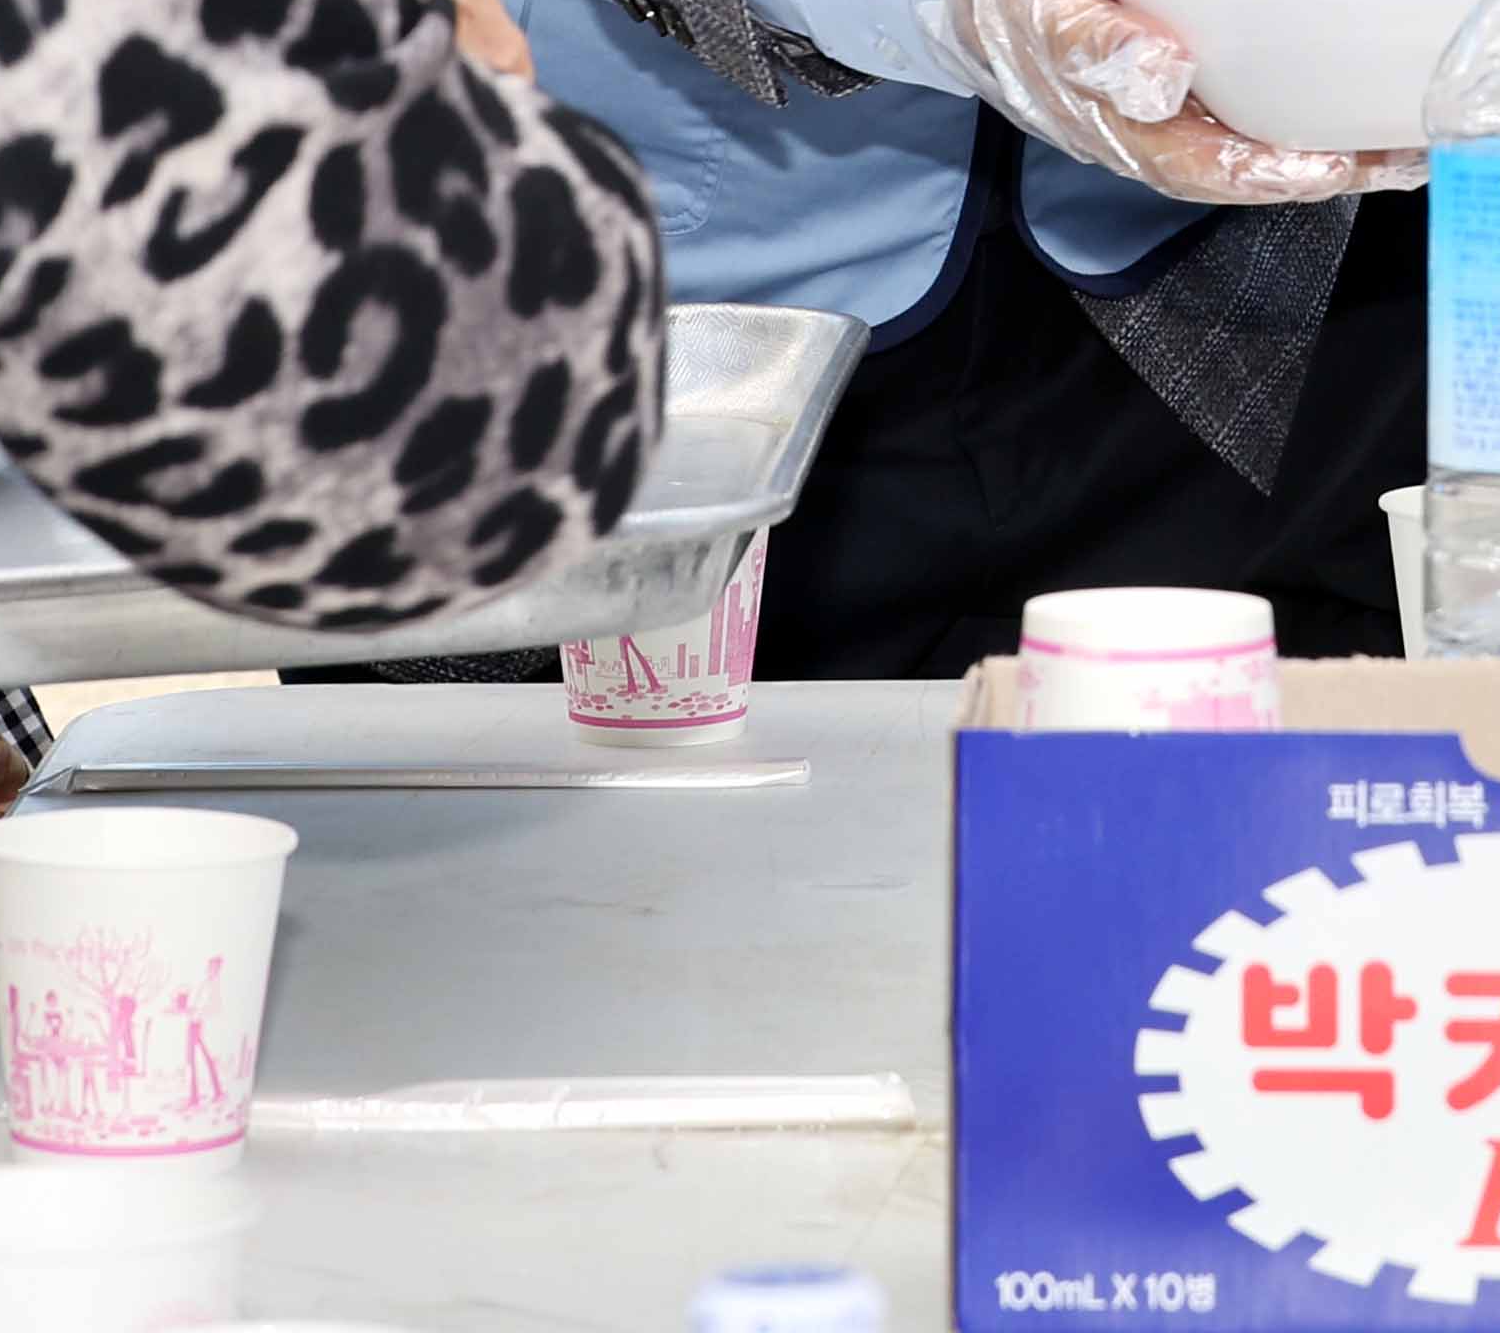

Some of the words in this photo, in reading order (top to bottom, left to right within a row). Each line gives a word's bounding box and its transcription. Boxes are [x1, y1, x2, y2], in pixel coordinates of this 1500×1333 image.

[1325, 779, 1490, 830] 피로회복
[994, 1271, 1106, 1312] 100mL
[1143, 1271, 1218, 1314] 10병
